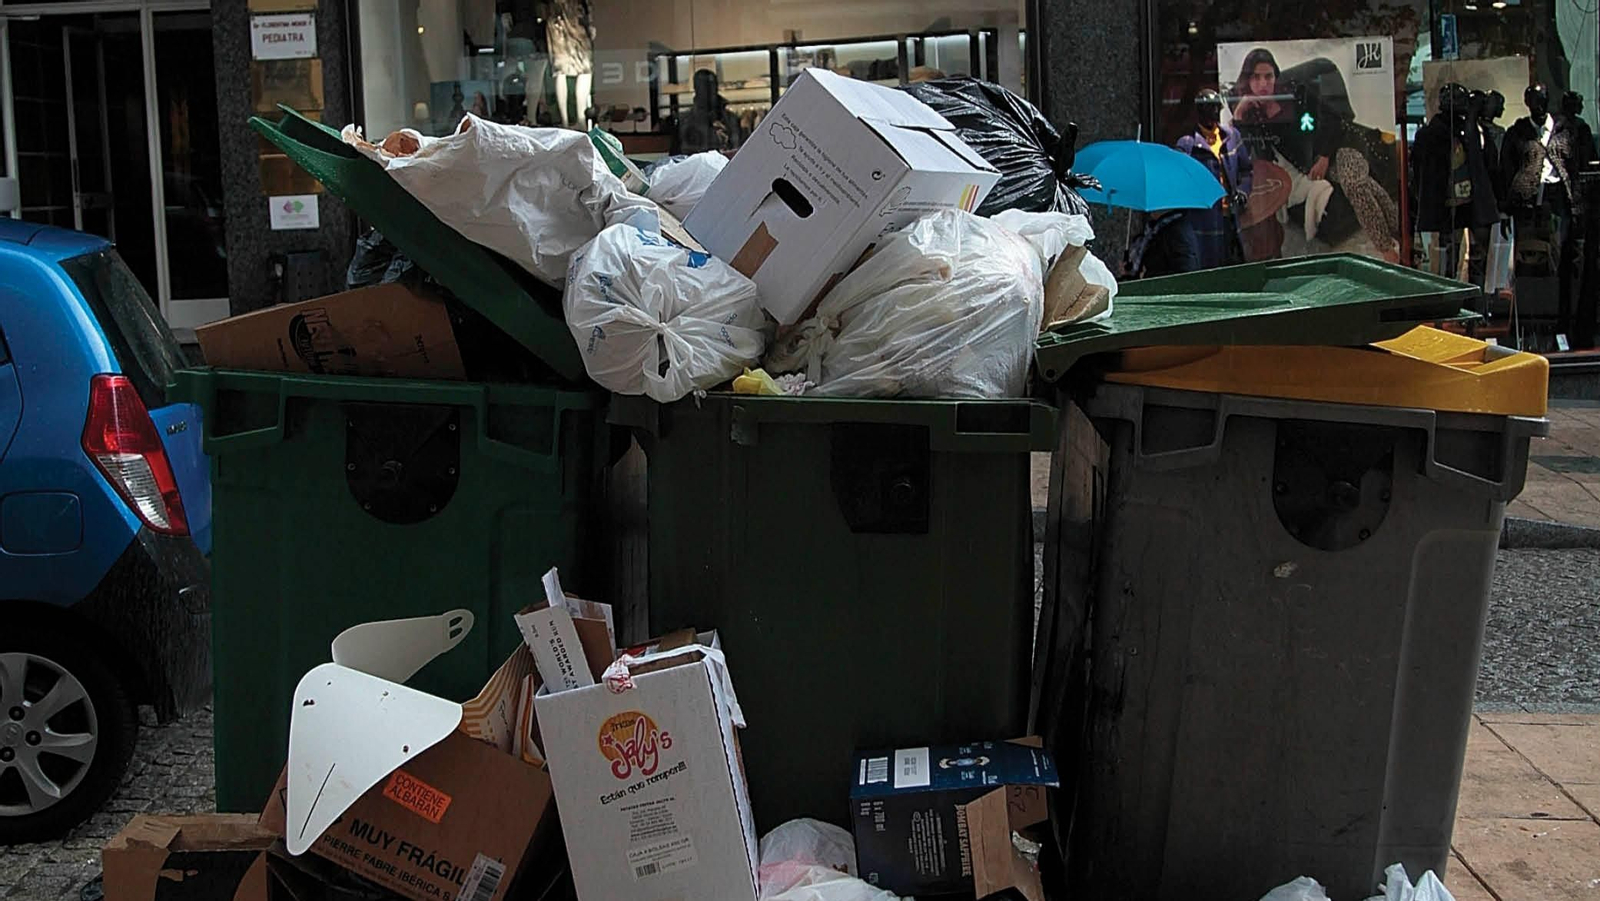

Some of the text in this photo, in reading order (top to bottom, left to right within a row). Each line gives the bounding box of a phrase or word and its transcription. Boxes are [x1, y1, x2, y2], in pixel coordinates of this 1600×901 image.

[262, 32, 305, 43] PEDIATRA
[548, 638, 567, 674] WORLD'S
[555, 637, 575, 677] AWARDED
[395, 774, 446, 809] CONTIENE
[600, 789, 627, 805] Están
[323, 834, 361, 861] PIERRE
[364, 852, 397, 876] FABRE
[349, 818, 395, 850] MUY
[396, 838, 466, 886] FRÁGIL
[953, 803, 973, 877] BOMBAY SAPPHIRE
